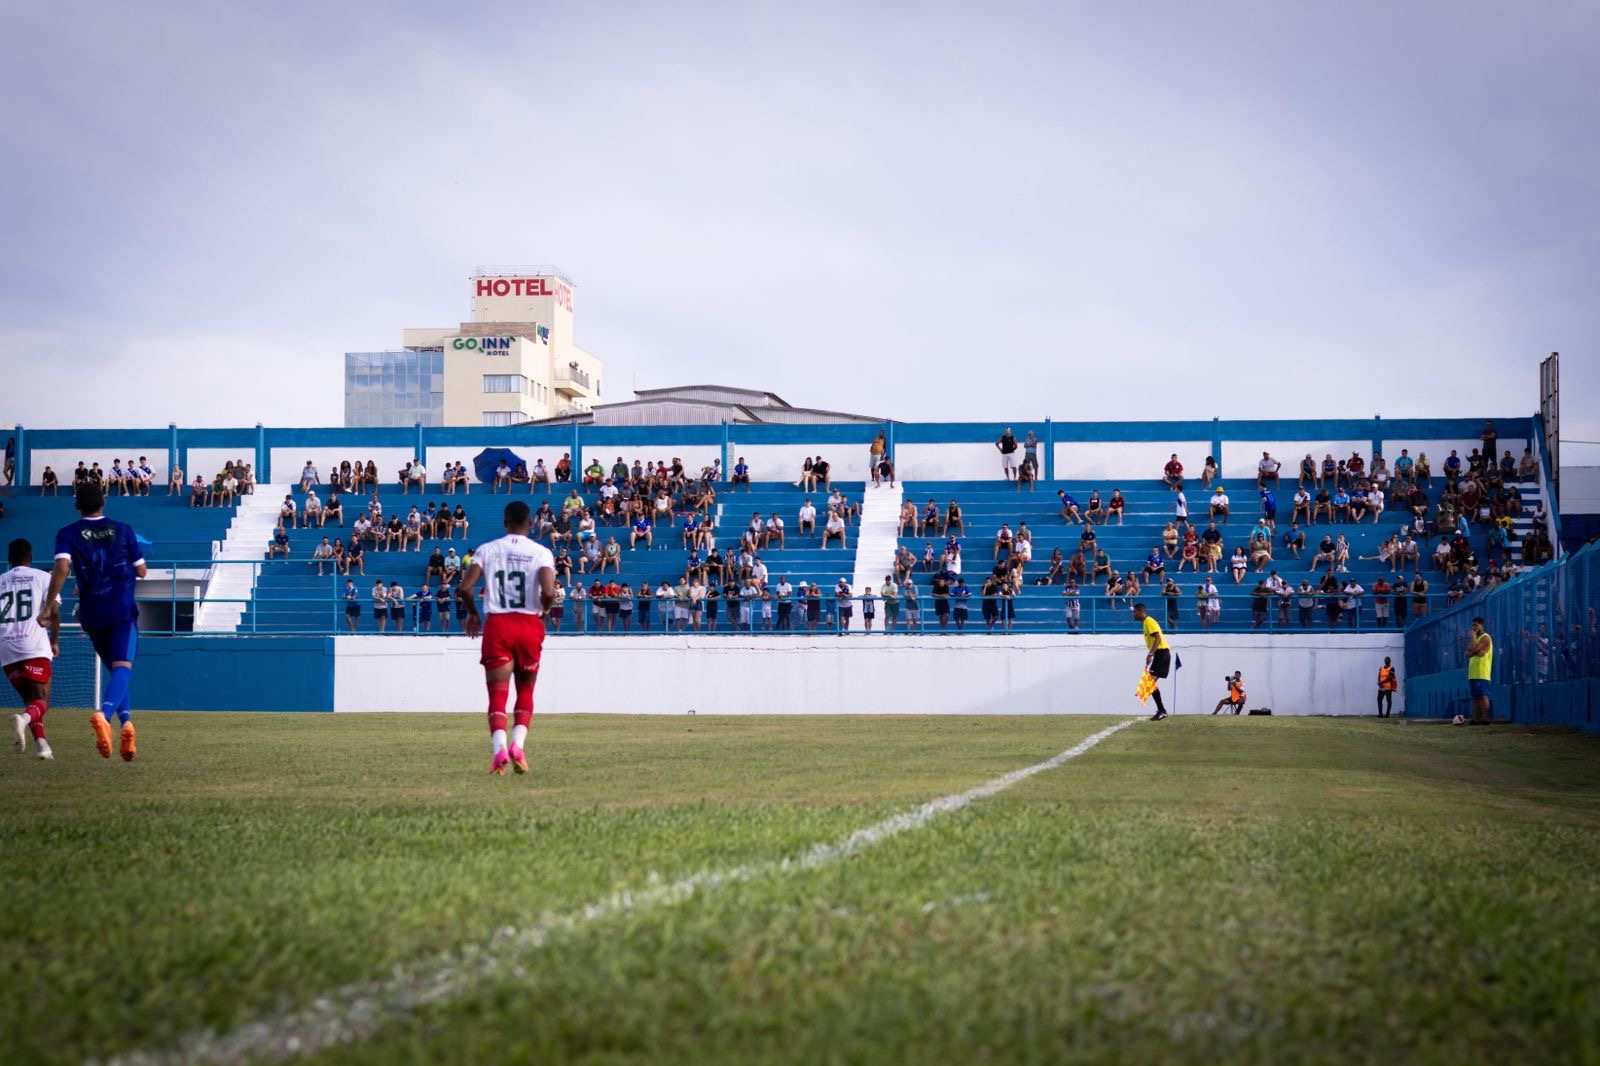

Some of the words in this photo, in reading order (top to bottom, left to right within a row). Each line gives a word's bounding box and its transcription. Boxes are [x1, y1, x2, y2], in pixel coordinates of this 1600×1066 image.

[477, 279, 553, 297] HOTEL
[555, 281, 573, 313] HOTEL
[453, 337, 478, 350] GO
[482, 337, 510, 349] INN
[495, 570, 526, 609] 13
[0, 589, 33, 623] 26
